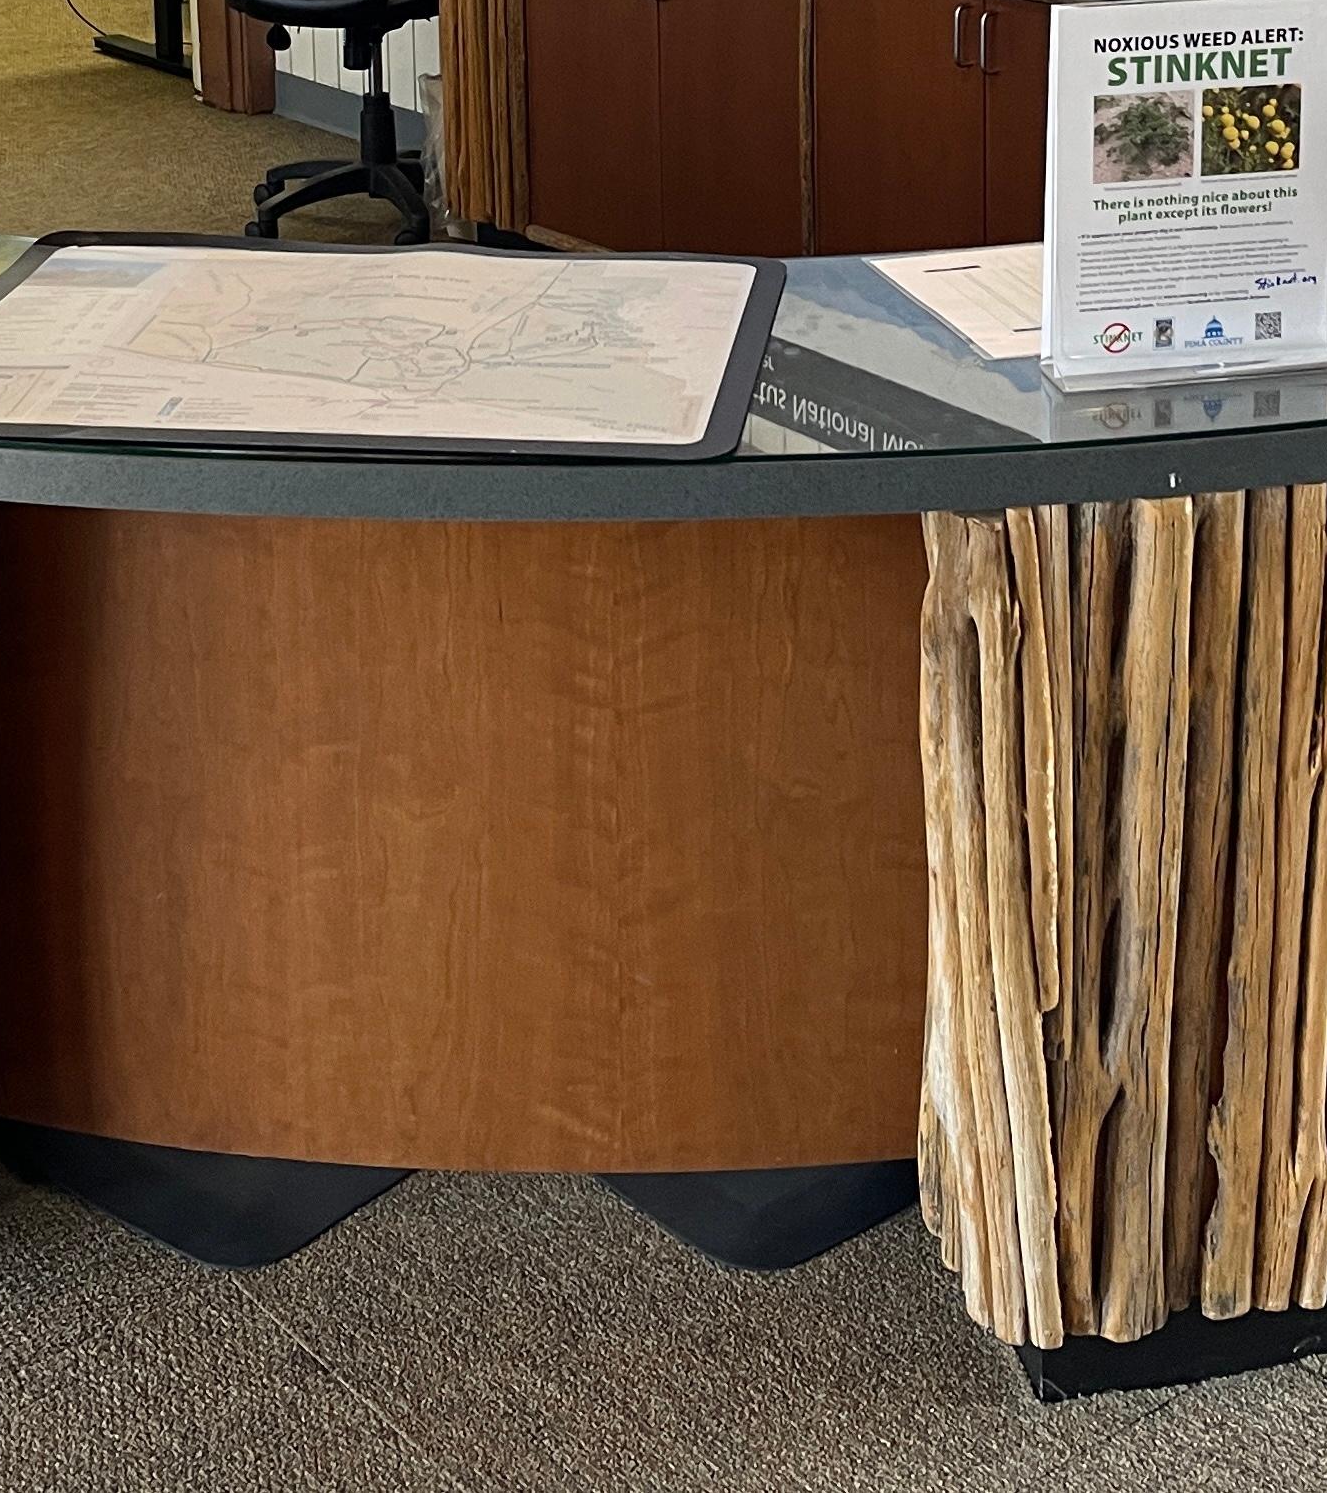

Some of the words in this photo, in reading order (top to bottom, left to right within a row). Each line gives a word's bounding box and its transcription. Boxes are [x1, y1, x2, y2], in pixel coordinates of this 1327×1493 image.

[1094, 34, 1179, 54] NOXIOUS
[1184, 31, 1237, 48] WEED
[1241, 27, 1304, 45] ALERT:
[1107, 47, 1293, 87] STINKNET
[1093, 199, 1131, 211] There
[1133, 196, 1144, 208] is
[1147, 193, 1199, 208] nothing
[1202, 191, 1229, 203] nice
[1232, 188, 1271, 201] about
[1273, 186, 1298, 198] this
[1118, 210, 1153, 225] plant
[1156, 206, 1199, 220] except
[1202, 204, 1218, 217] its
[1221, 201, 1272, 215] flowers!
